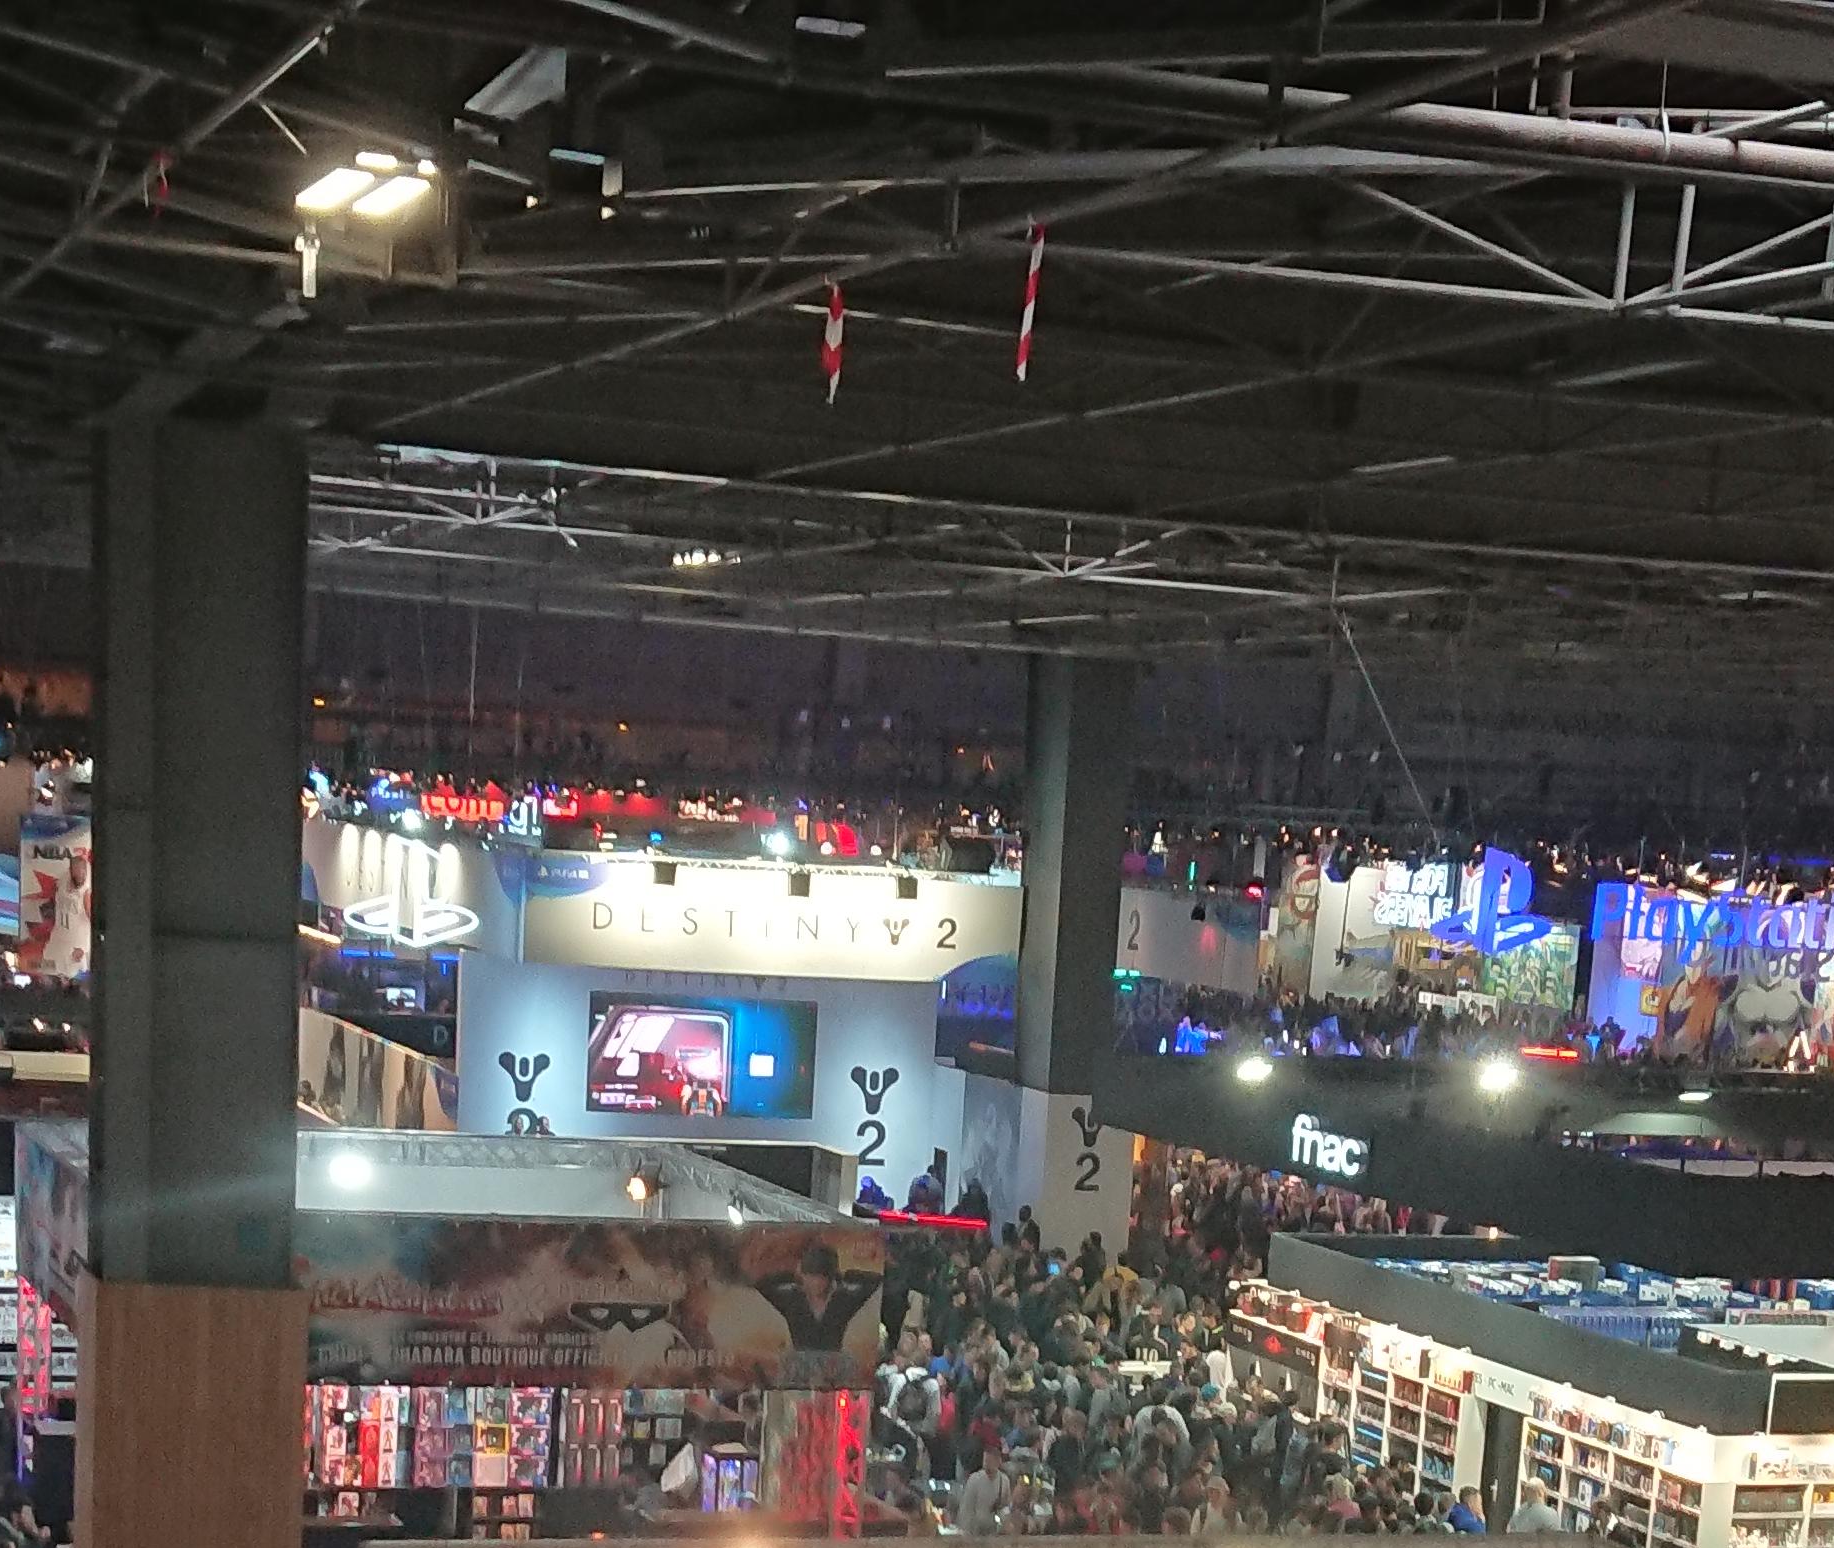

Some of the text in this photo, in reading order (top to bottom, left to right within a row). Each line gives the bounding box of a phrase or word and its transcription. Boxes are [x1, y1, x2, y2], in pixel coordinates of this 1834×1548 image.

[936, 918, 958, 950] 2
[857, 1120, 886, 1166] 2
[1292, 1113, 1362, 1175] fnac
[1075, 1152, 1100, 1191] 2
